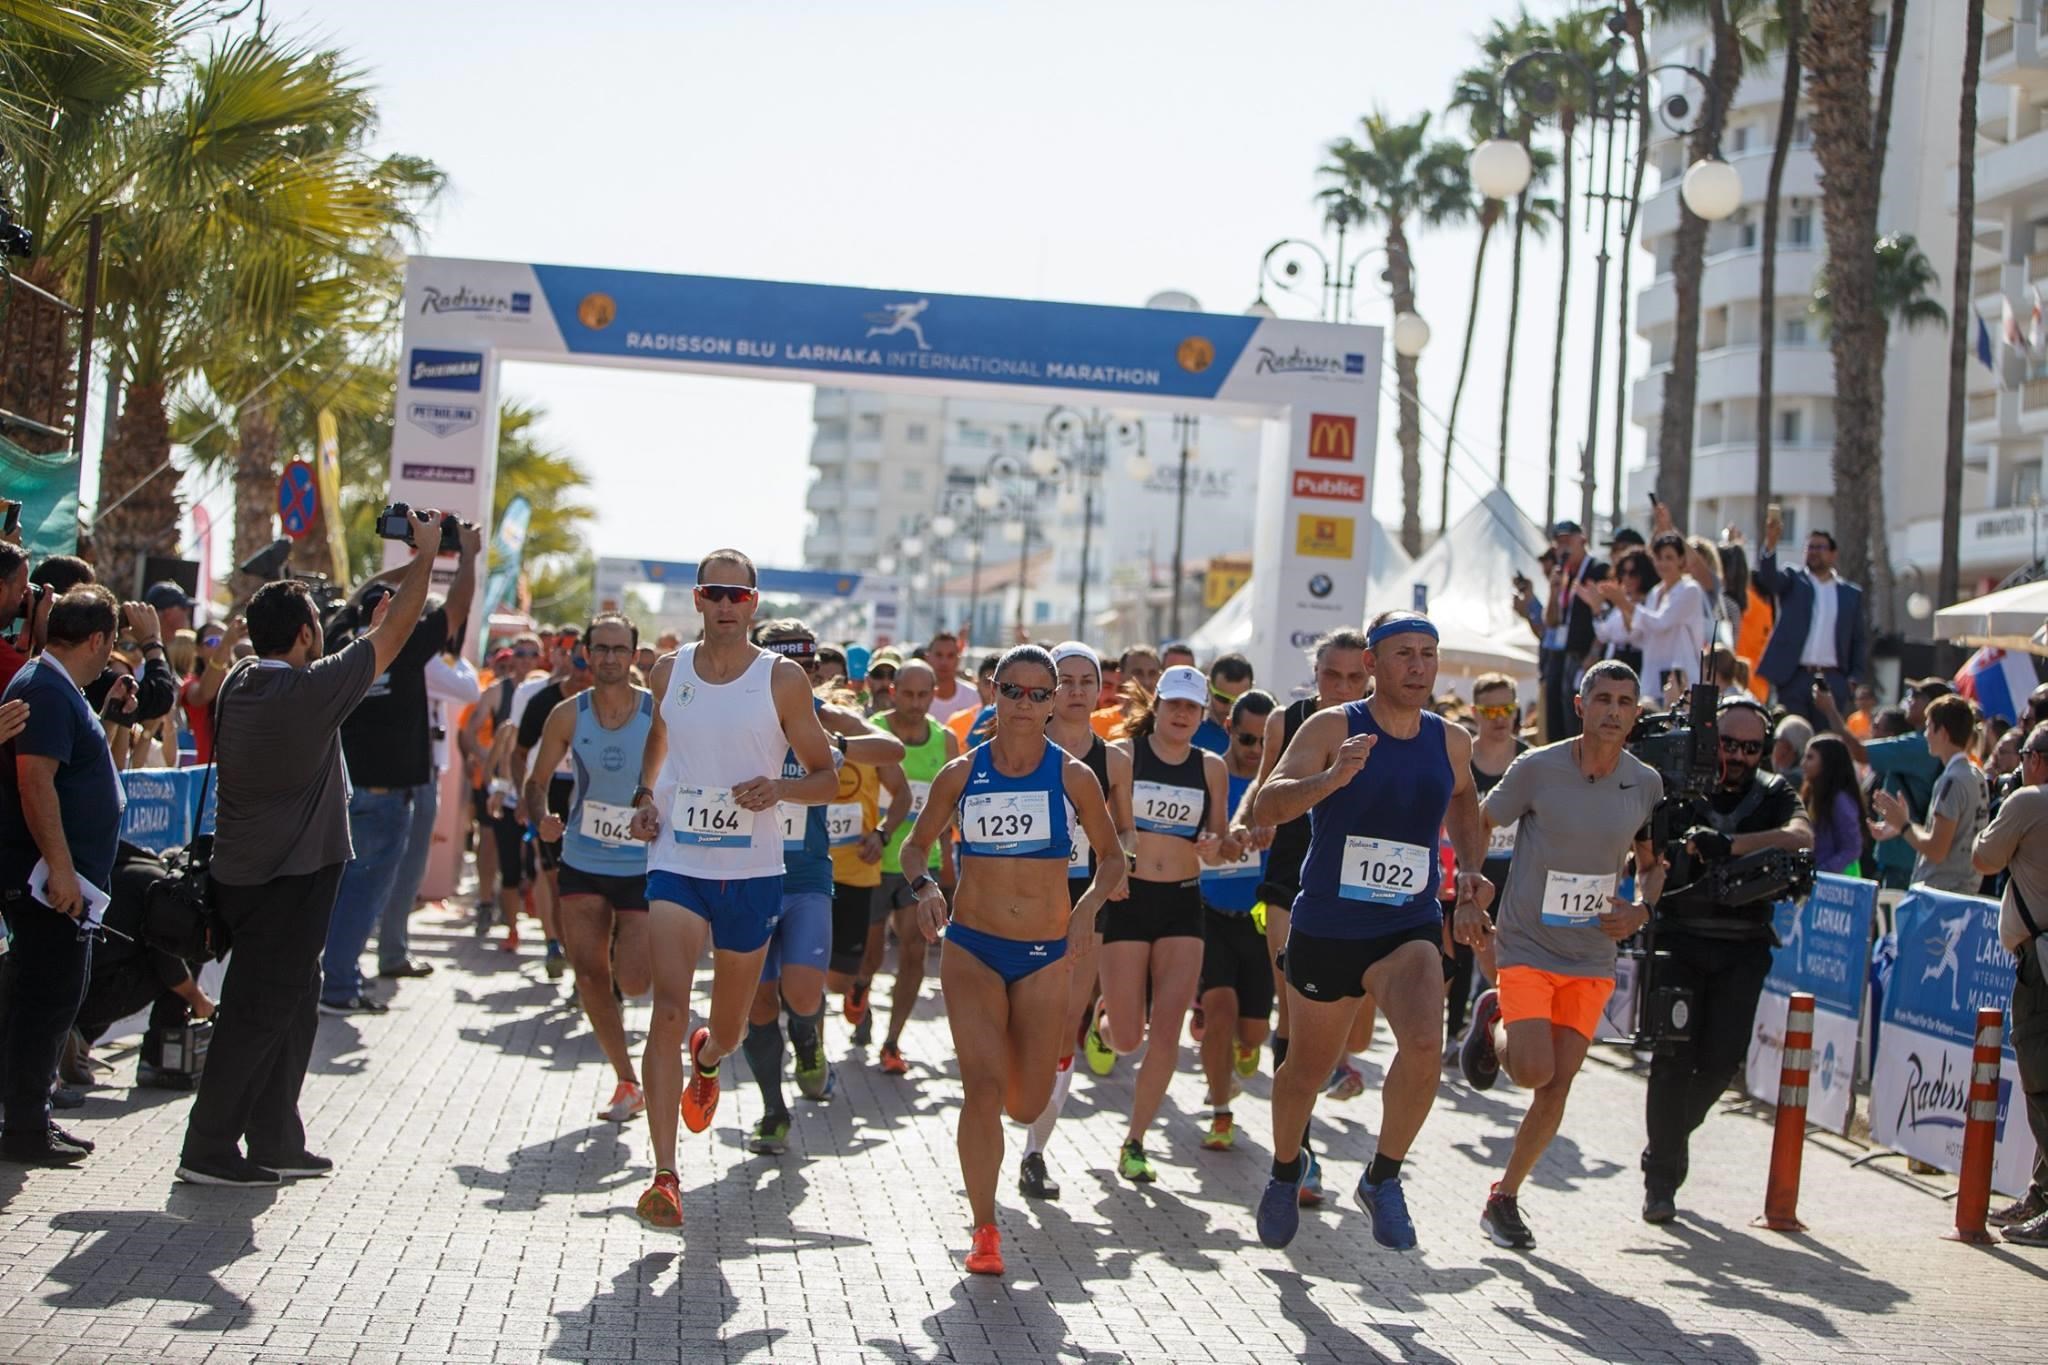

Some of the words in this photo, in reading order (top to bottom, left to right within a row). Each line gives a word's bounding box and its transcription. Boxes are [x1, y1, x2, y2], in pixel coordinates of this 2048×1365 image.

[421, 285, 508, 315] Radisson
[626, 332, 732, 356] RADISSON
[737, 338, 776, 358] BLU
[786, 344, 881, 366] LARNAKA
[887, 351, 1041, 378] INTERNATIONAL
[1046, 362, 1160, 386] MARATHON
[1296, 477, 1361, 498] Public
[127, 806, 169, 834] LARNAKA
[687, 807, 739, 830] 1164
[1146, 799, 1191, 822] 1202
[977, 814, 1033, 836] 1239
[1360, 860, 1414, 888] 1022
[1560, 893, 1603, 912] 1124
[1811, 904, 1852, 938] LARNAKA
